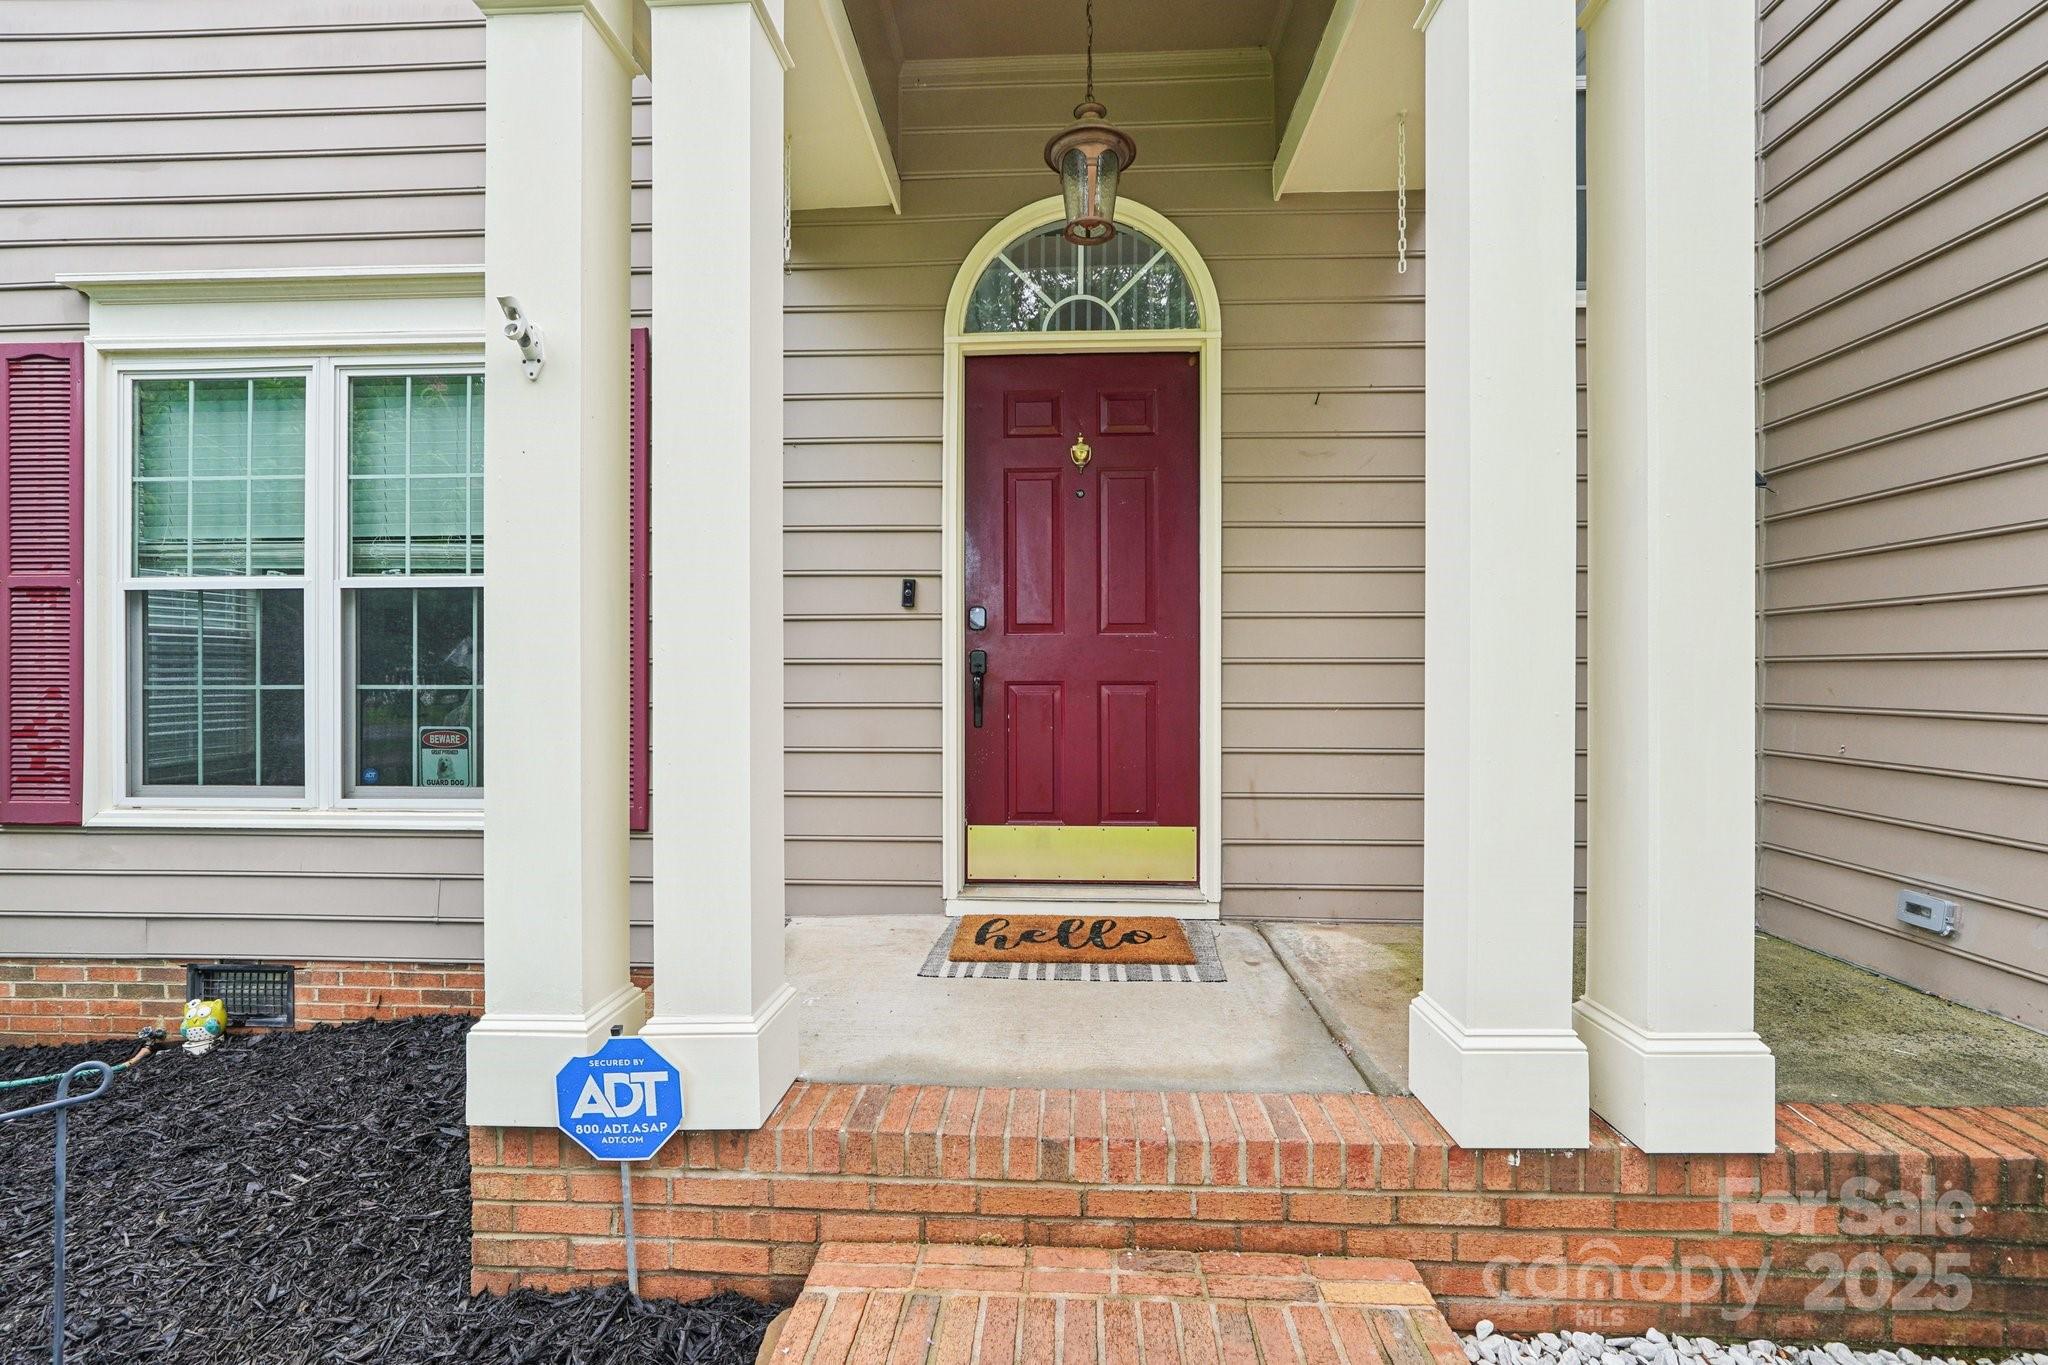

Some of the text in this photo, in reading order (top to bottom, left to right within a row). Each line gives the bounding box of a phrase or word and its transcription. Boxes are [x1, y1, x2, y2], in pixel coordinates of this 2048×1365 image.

[429, 735, 461, 744] BEWARE
[975, 917, 1167, 950] hello
[589, 1058, 645, 1067] SECURED BY
[570, 1071, 669, 1119] ADT
[575, 1122, 668, 1134] 800.ADT.ASAP
[602, 1136, 644, 1144] ADT.COM
